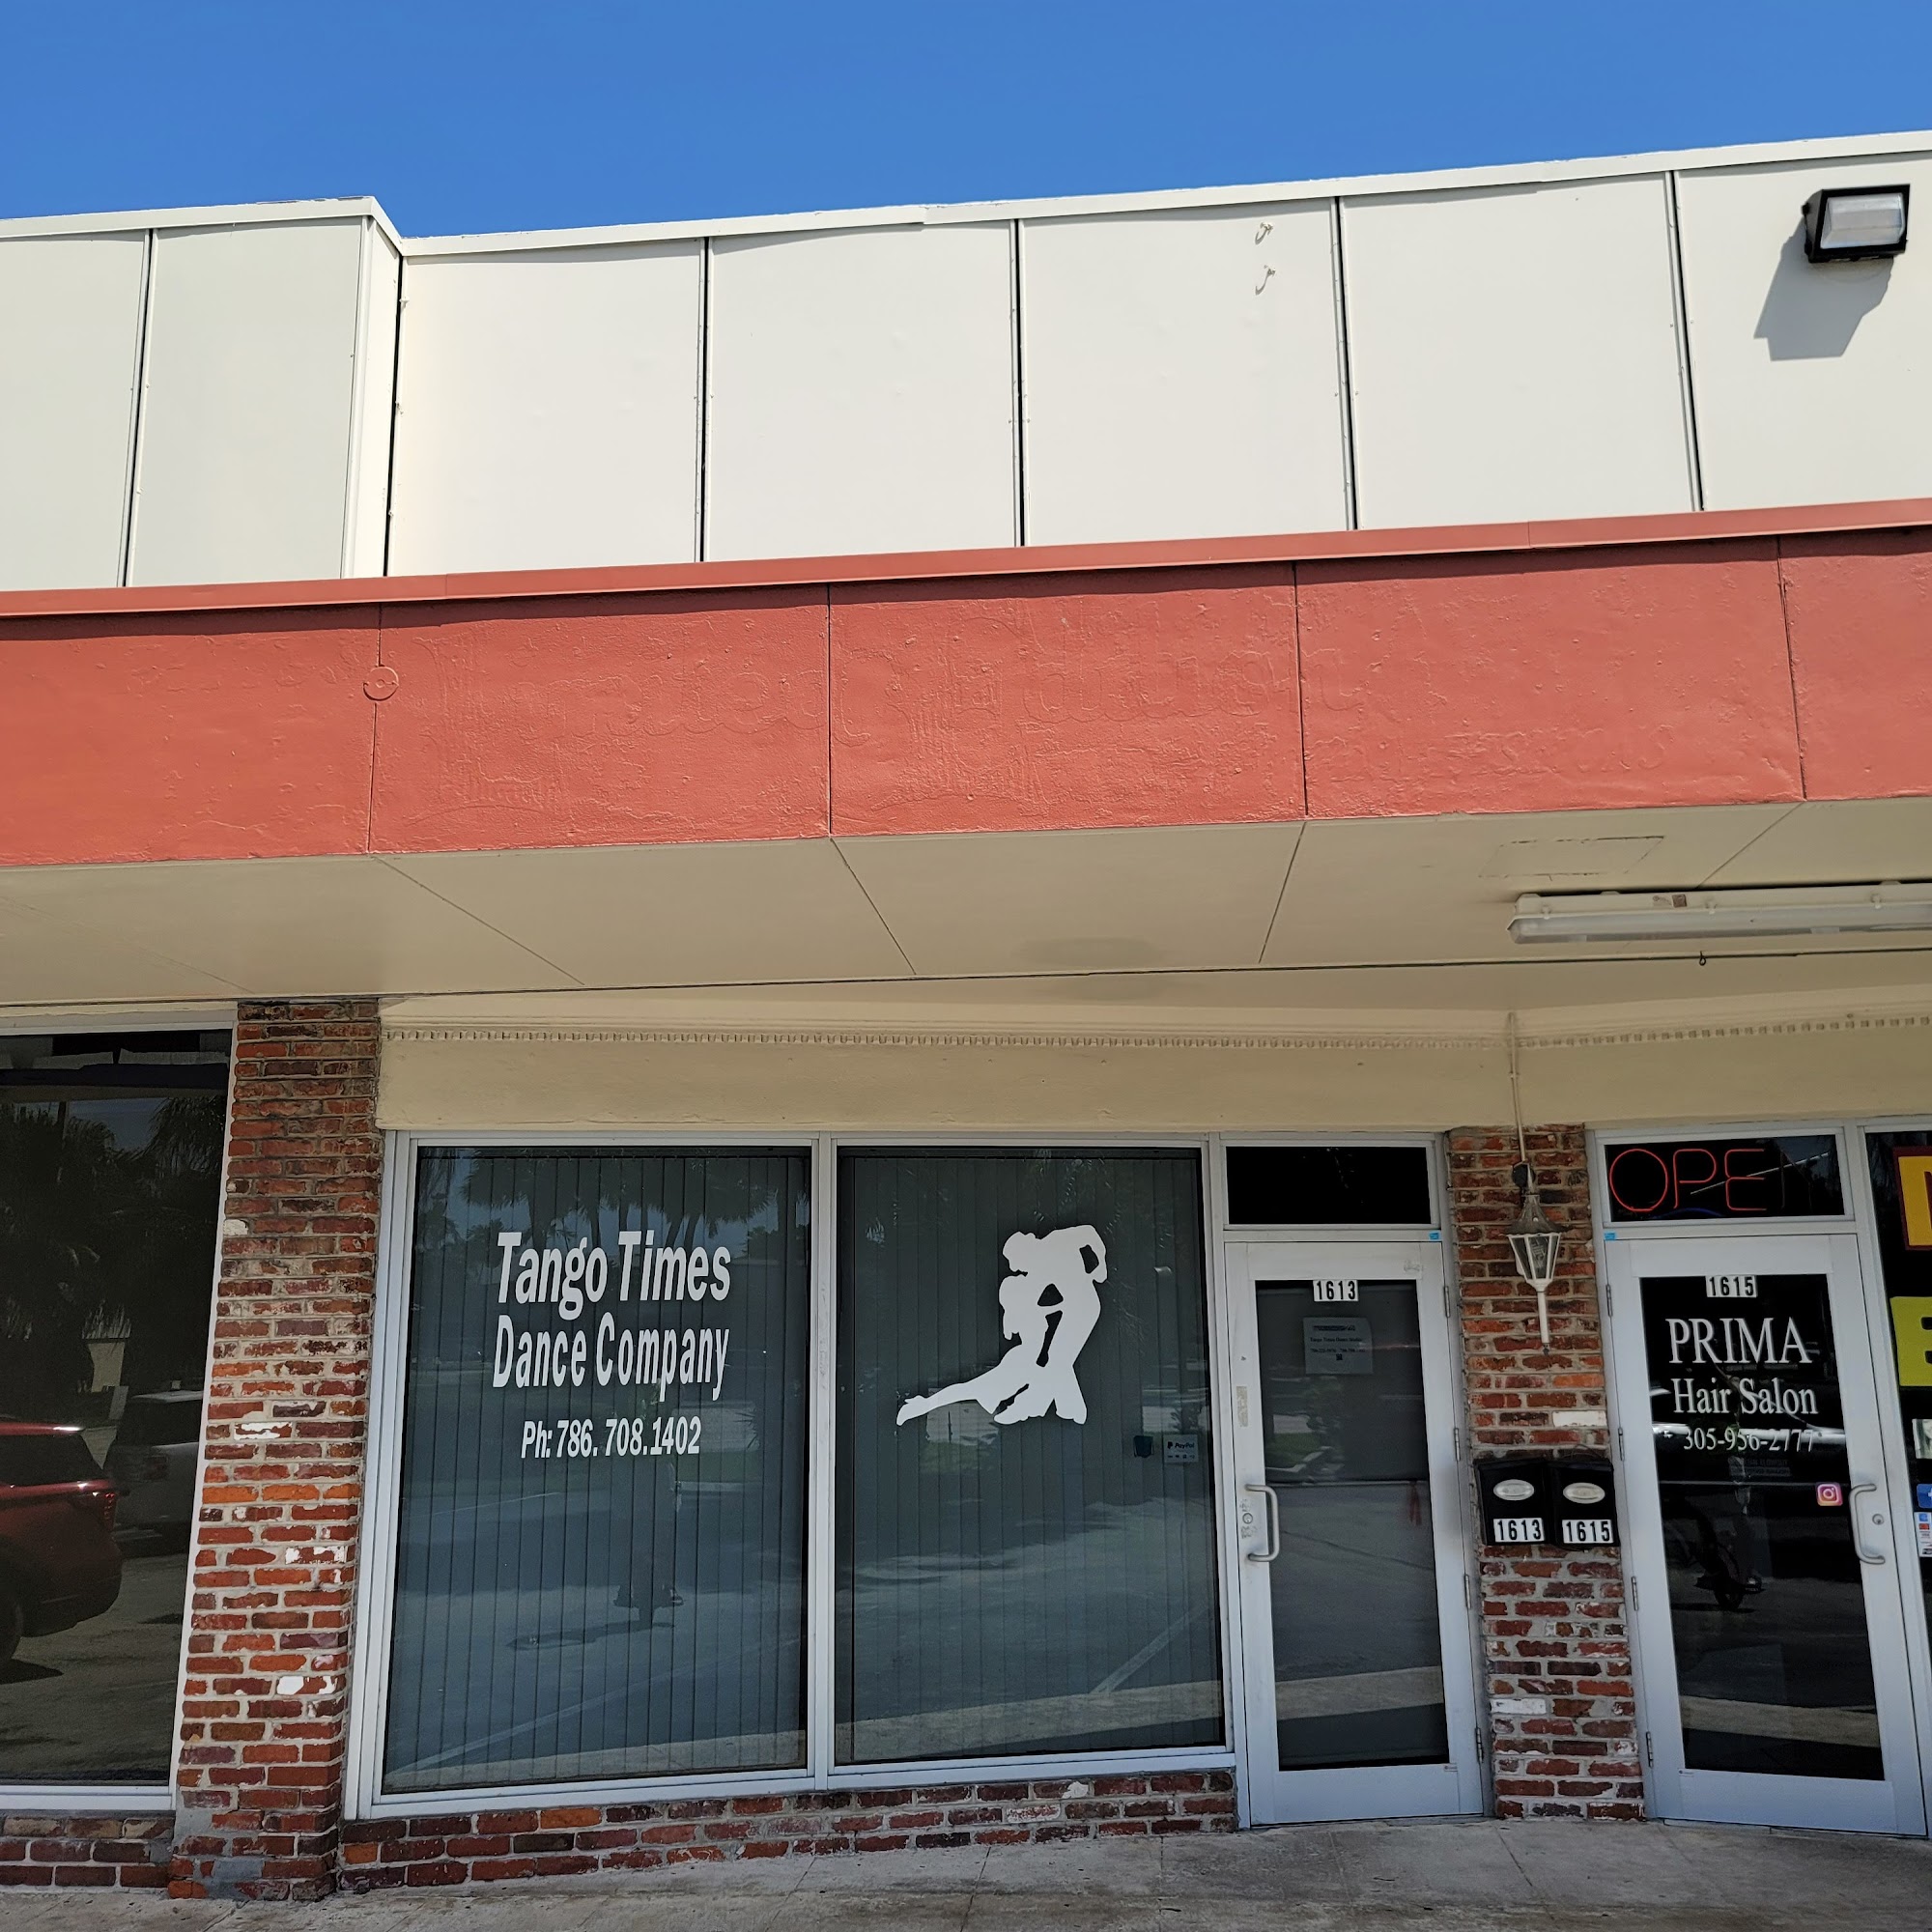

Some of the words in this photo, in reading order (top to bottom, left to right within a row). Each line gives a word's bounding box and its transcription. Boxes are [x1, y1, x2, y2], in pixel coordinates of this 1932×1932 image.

[497, 1232, 609, 1321] Tango
[617, 1230, 731, 1302] Times
[1709, 1276, 1754, 1296] 1615
[1316, 1280, 1356, 1300] 1613
[1664, 1316, 1813, 1364] PRIMA
[493, 1314, 587, 1389] Dance
[595, 1312, 730, 1403] Company
[1670, 1377, 1732, 1414] Hair
[1739, 1377, 1819, 1414] Salon
[1174, 1441, 1195, 1450] PayPal
[1683, 1427, 1815, 1453] 305-956-2777
[1497, 1519, 1542, 1541] 1613
[1566, 1520, 1610, 1542] 1615
